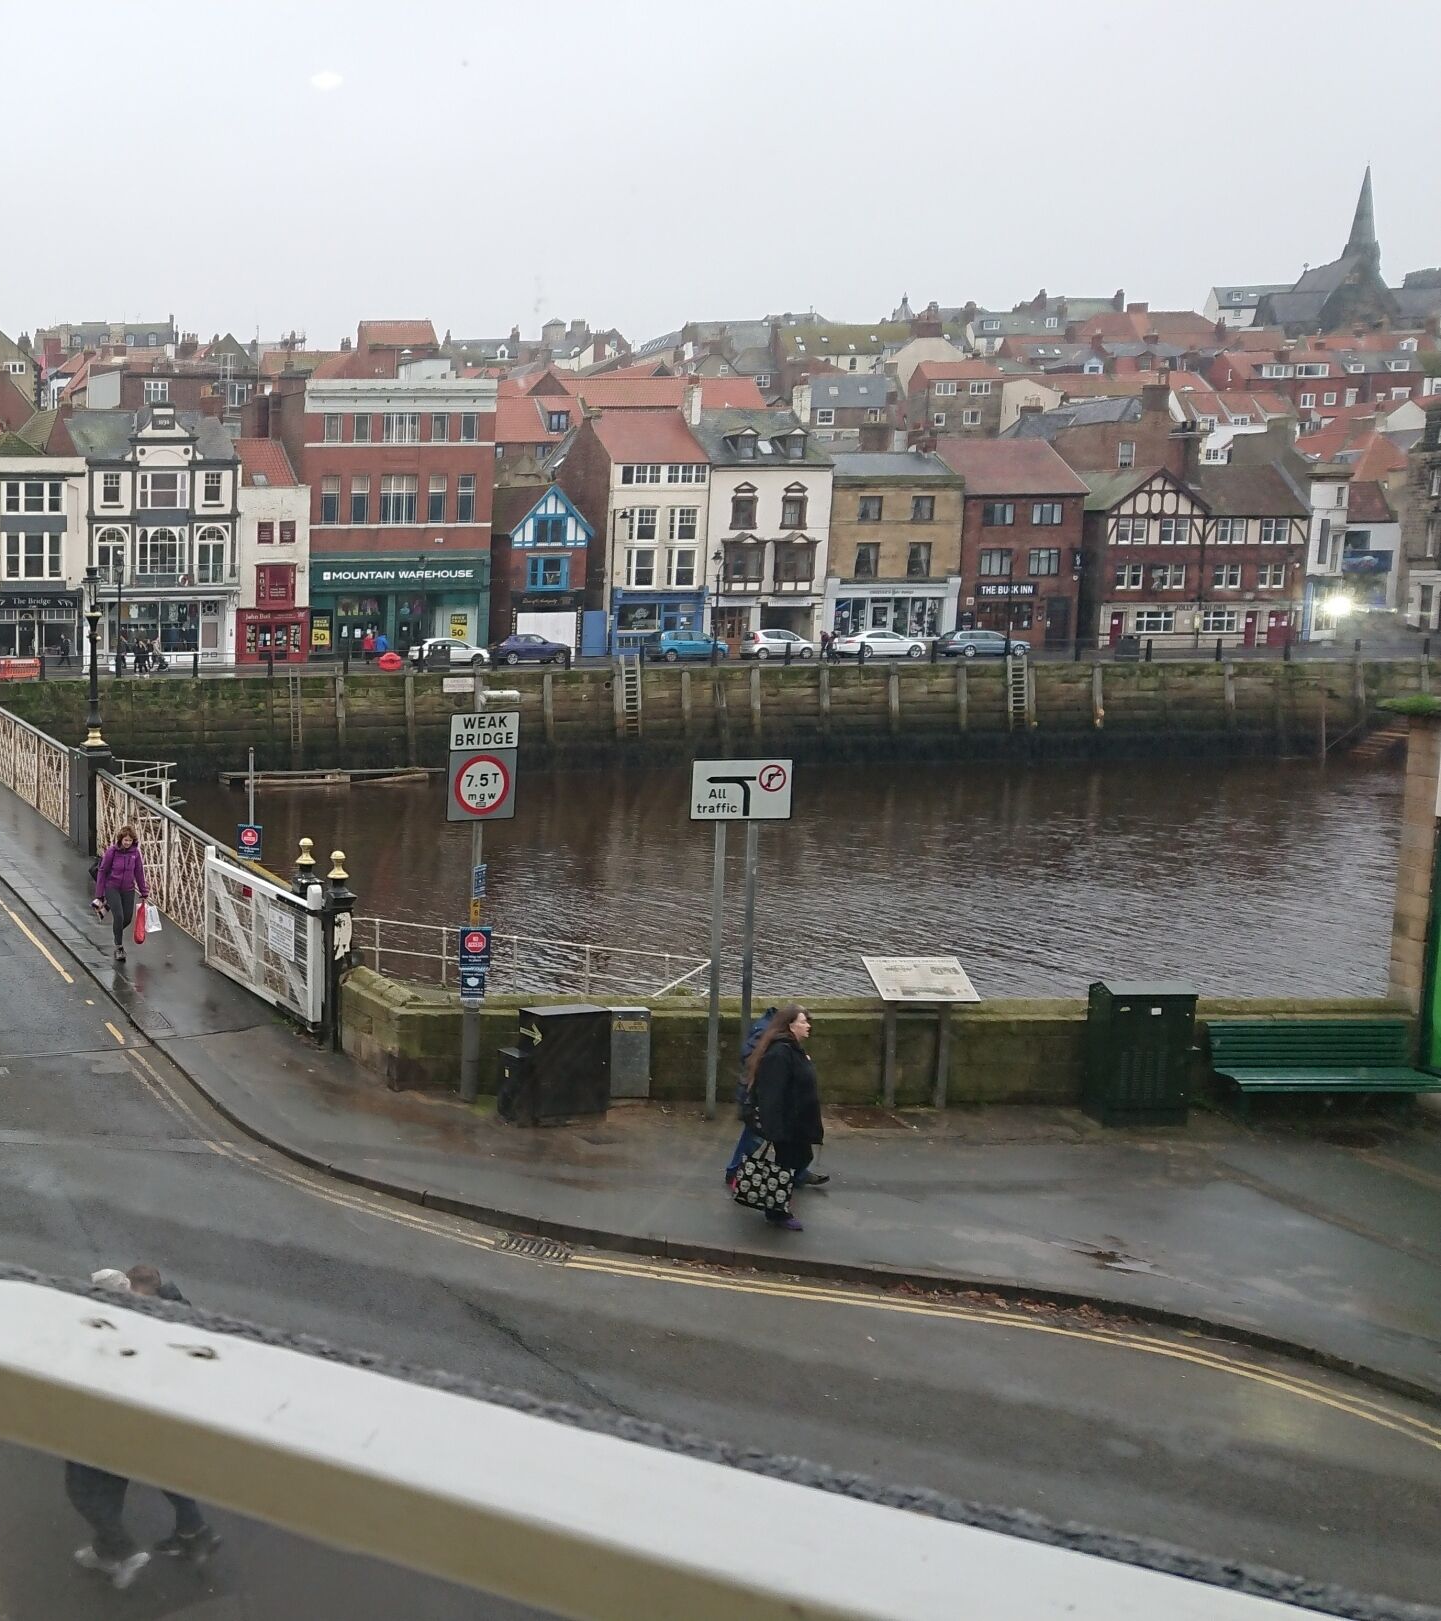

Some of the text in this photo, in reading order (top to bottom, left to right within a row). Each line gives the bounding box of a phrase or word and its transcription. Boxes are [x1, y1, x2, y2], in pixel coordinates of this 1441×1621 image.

[332, 569, 474, 580] MOUNTAIN WAREHOUSE
[982, 586, 996, 594] THE
[1021, 585, 1033, 594] INN
[12, 597, 52, 606] The Bridge
[463, 715, 507, 730] WEAK
[455, 732, 514, 747] BRIDGE
[708, 788, 727, 799] All
[697, 803, 738, 814] traffic
